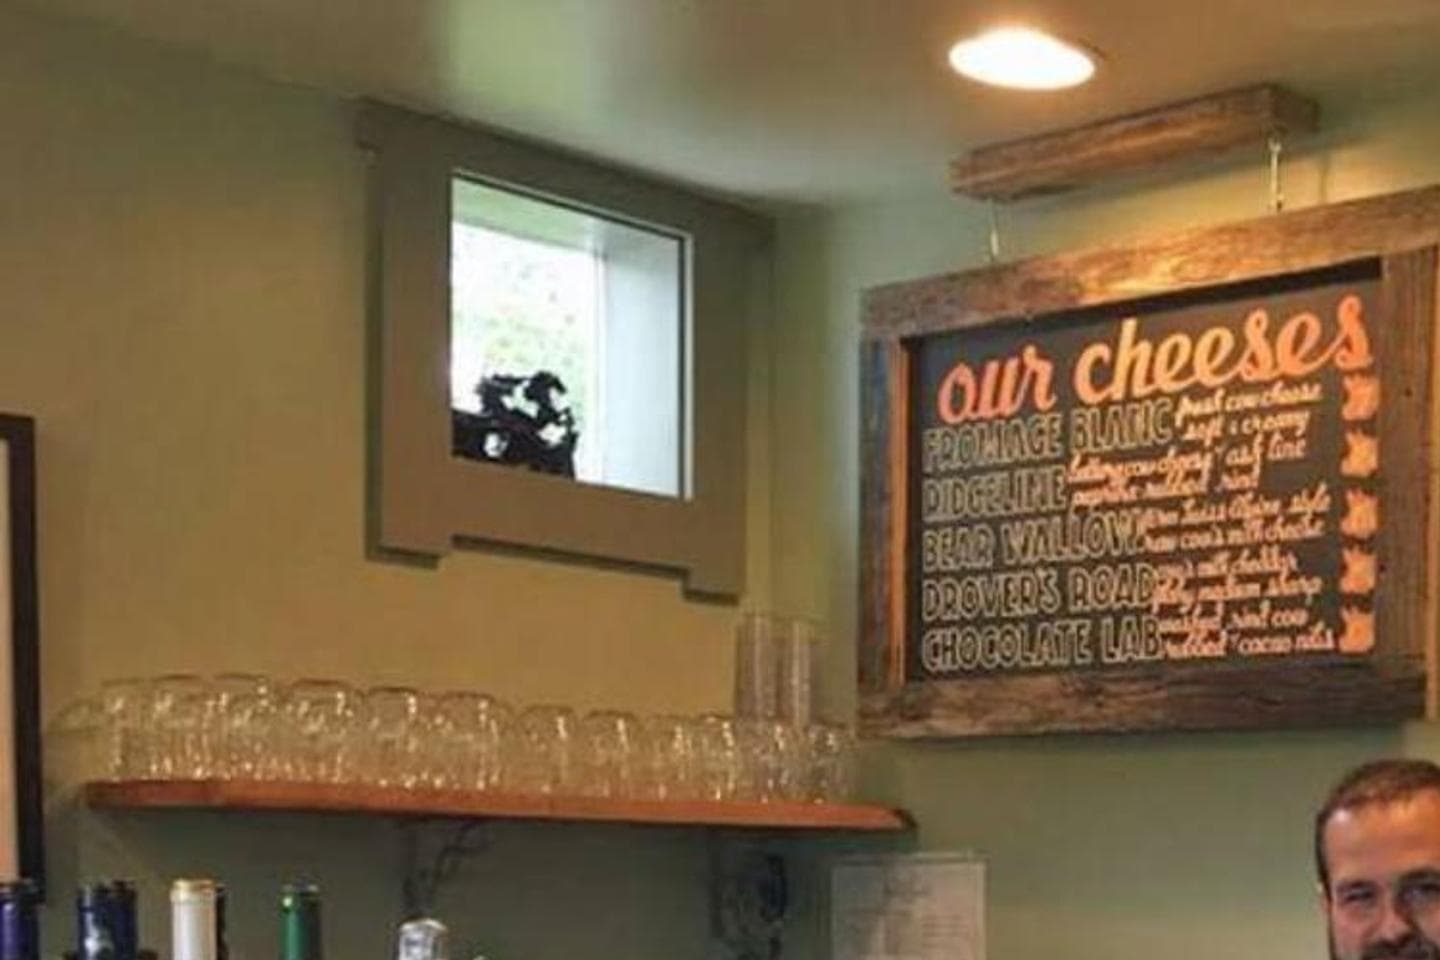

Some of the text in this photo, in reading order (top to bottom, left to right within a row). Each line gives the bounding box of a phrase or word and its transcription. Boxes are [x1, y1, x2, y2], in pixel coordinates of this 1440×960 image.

[937, 295, 1374, 424] our cheeses
[922, 414, 1065, 473] FROMAGE
[1070, 398, 1173, 452] BLANC
[922, 465, 1068, 524] RIDGELINE
[922, 524, 996, 573] BEAR
[1003, 507, 1147, 566] WALLOW
[922, 568, 1061, 623] DROVER'S
[1068, 562, 1160, 614] ROAD
[922, 617, 1095, 674] CHOCOLATE
[1101, 615, 1166, 665] LAB
